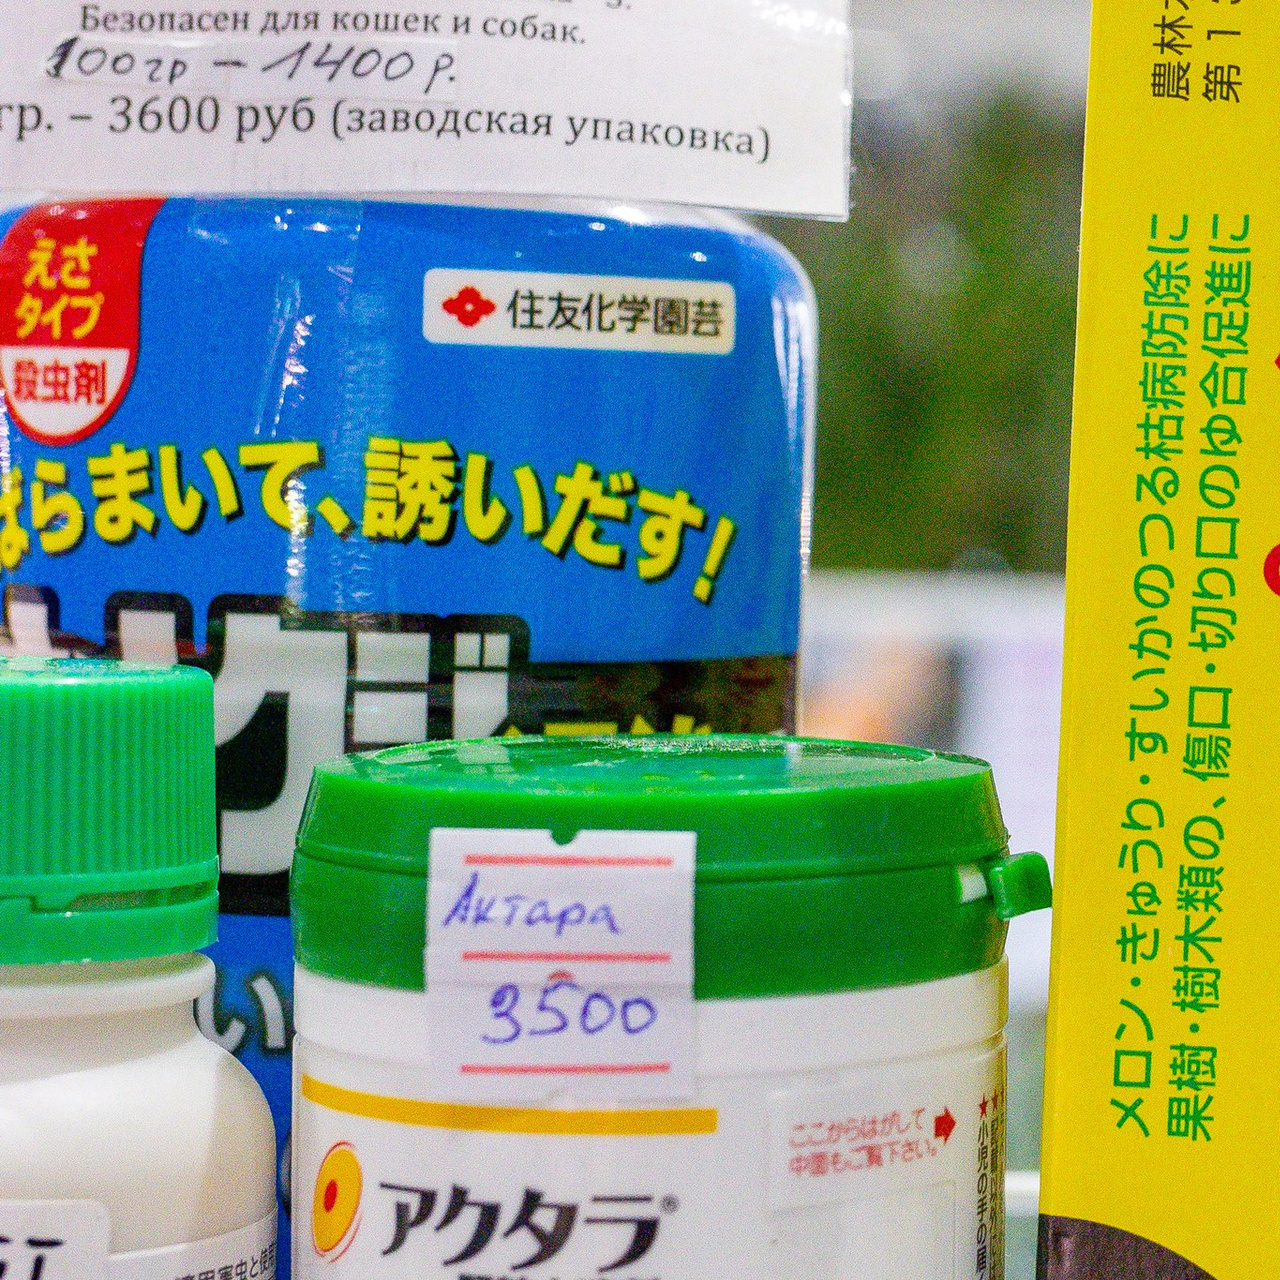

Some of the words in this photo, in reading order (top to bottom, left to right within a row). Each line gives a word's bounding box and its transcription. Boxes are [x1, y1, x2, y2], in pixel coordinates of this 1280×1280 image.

[79, 2, 250, 34] Безопасен
[259, 11, 320, 36] для
[331, 11, 441, 34] кошек
[451, 13, 472, 35] и
[482, 15, 586, 46] собак.
[262, 40, 415, 83] 1400
[108, 95, 221, 134] 3600
[236, 94, 316, 143] руб
[332, 97, 552, 141] (заводская
[564, 114, 771, 165] упаковка)
[24, 237, 99, 290] えさ
[14, 290, 105, 341] タイプ
[506, 288, 725, 339] 住友化学園芸
[12, 357, 109, 407] 殺虫剤
[1110, 212, 1190, 1139] メロン・きゅうり・すいかのつる枯病防除に
[442, 871, 620, 938] Актара
[480, 980, 659, 1045] 3500
[379, 1179, 660, 1273] アクタラ
